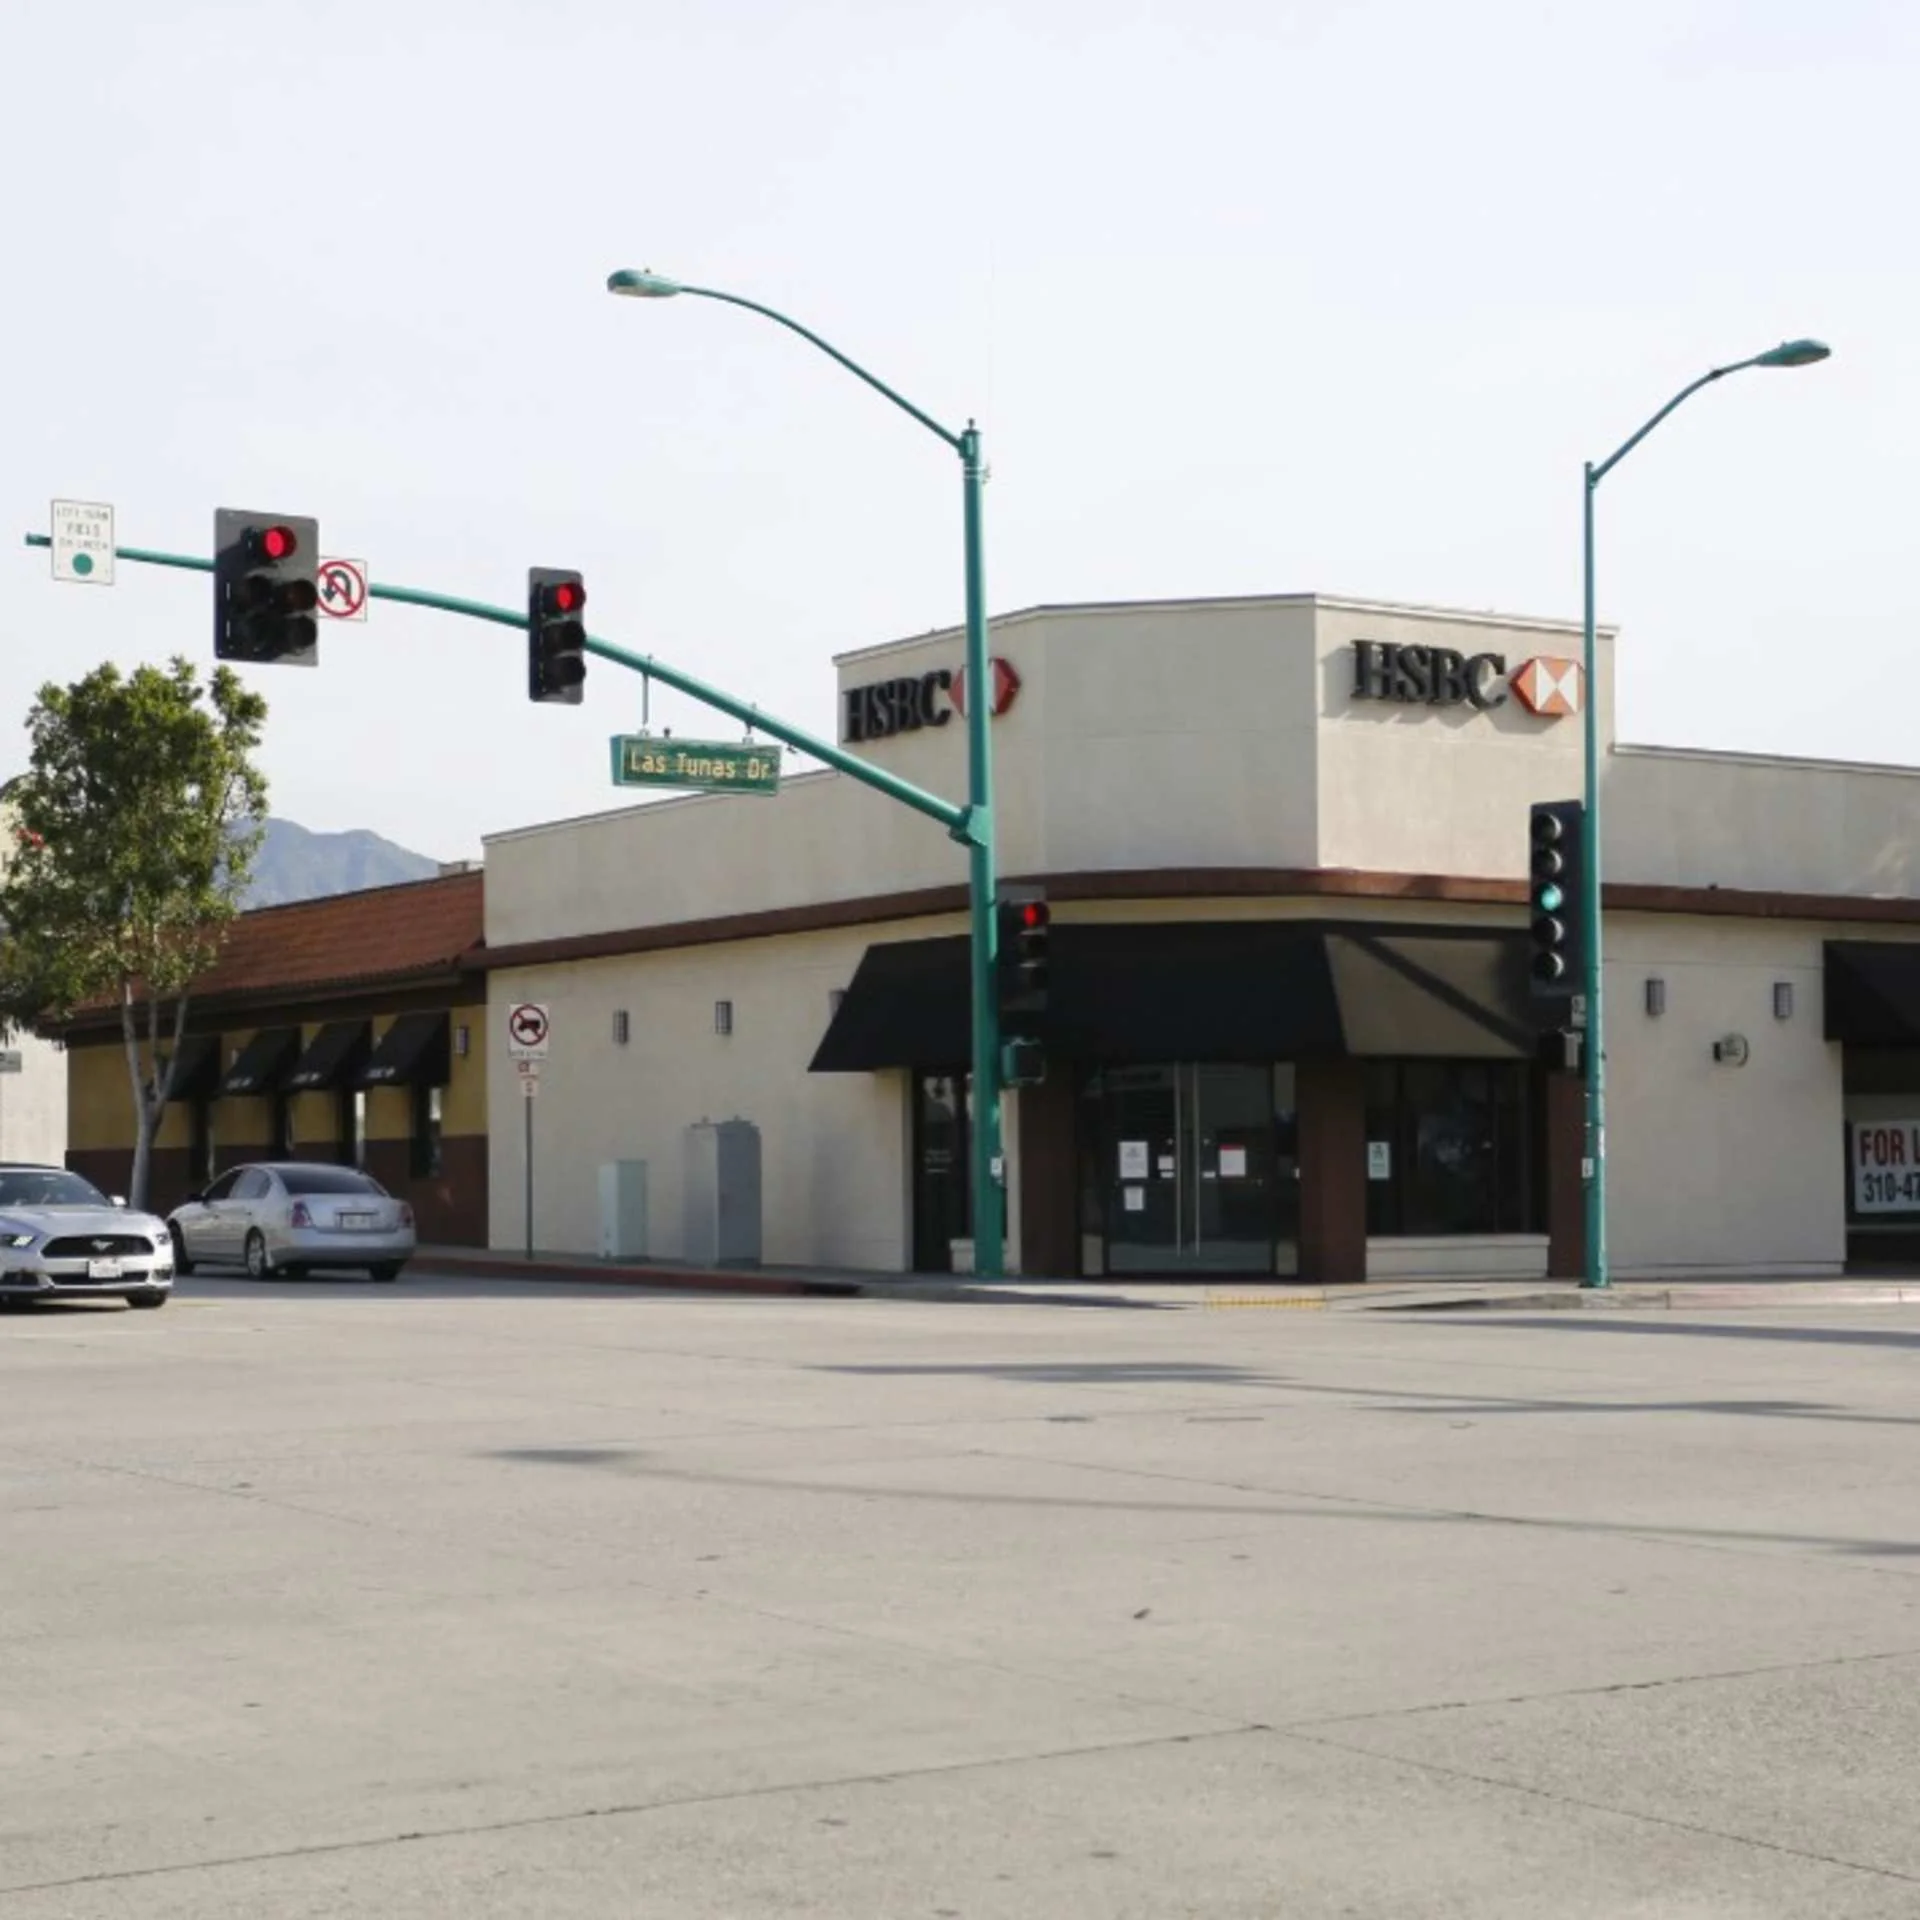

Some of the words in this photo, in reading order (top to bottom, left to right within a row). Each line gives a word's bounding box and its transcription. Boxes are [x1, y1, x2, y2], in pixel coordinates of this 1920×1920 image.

[1351, 639, 1507, 711] HSBC
[842, 669, 952, 743] HSBC
[631, 751, 666, 773] Las
[676, 752, 737, 779] Tunas
[1859, 1128, 1906, 1167] FOR
